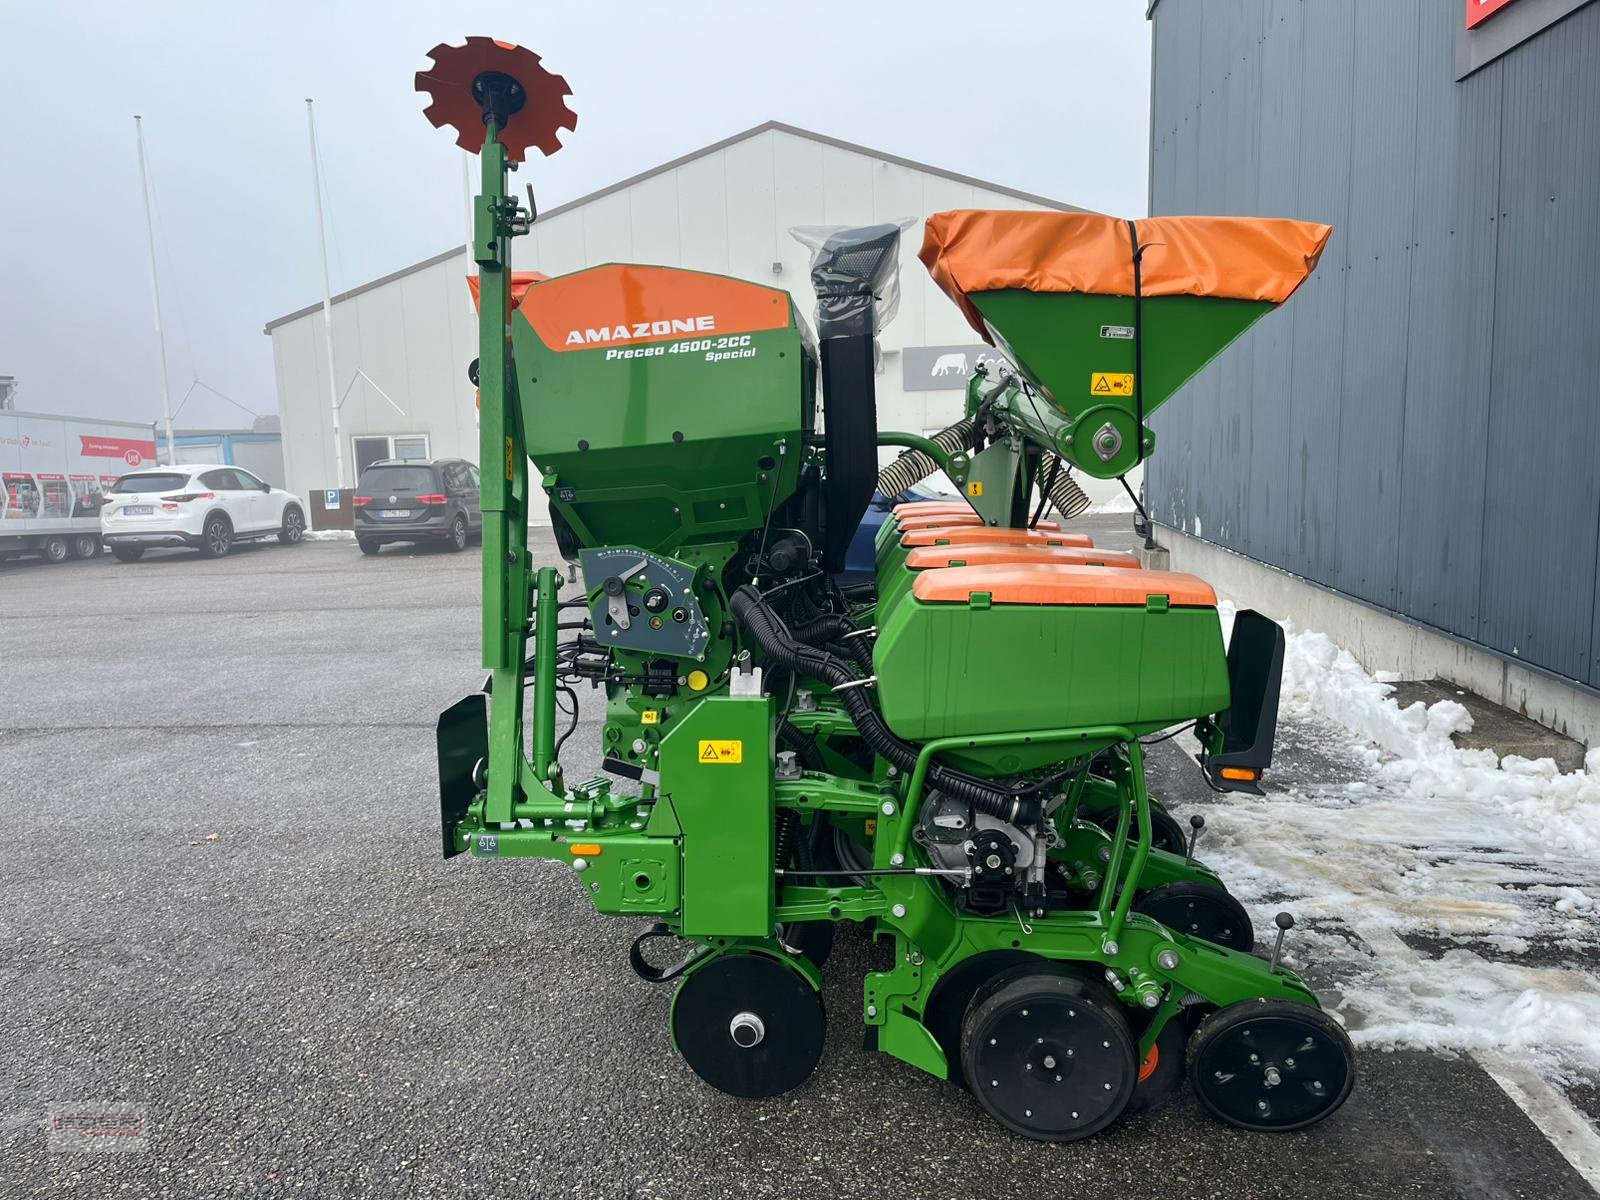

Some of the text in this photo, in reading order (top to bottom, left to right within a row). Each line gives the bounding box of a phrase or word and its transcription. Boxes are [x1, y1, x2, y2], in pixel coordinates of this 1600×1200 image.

[565, 315, 716, 346] AMAZONE
[605, 334, 752, 361] Precea 4500-2CC
[704, 347, 756, 363] Special
[327, 491, 336, 502] P
